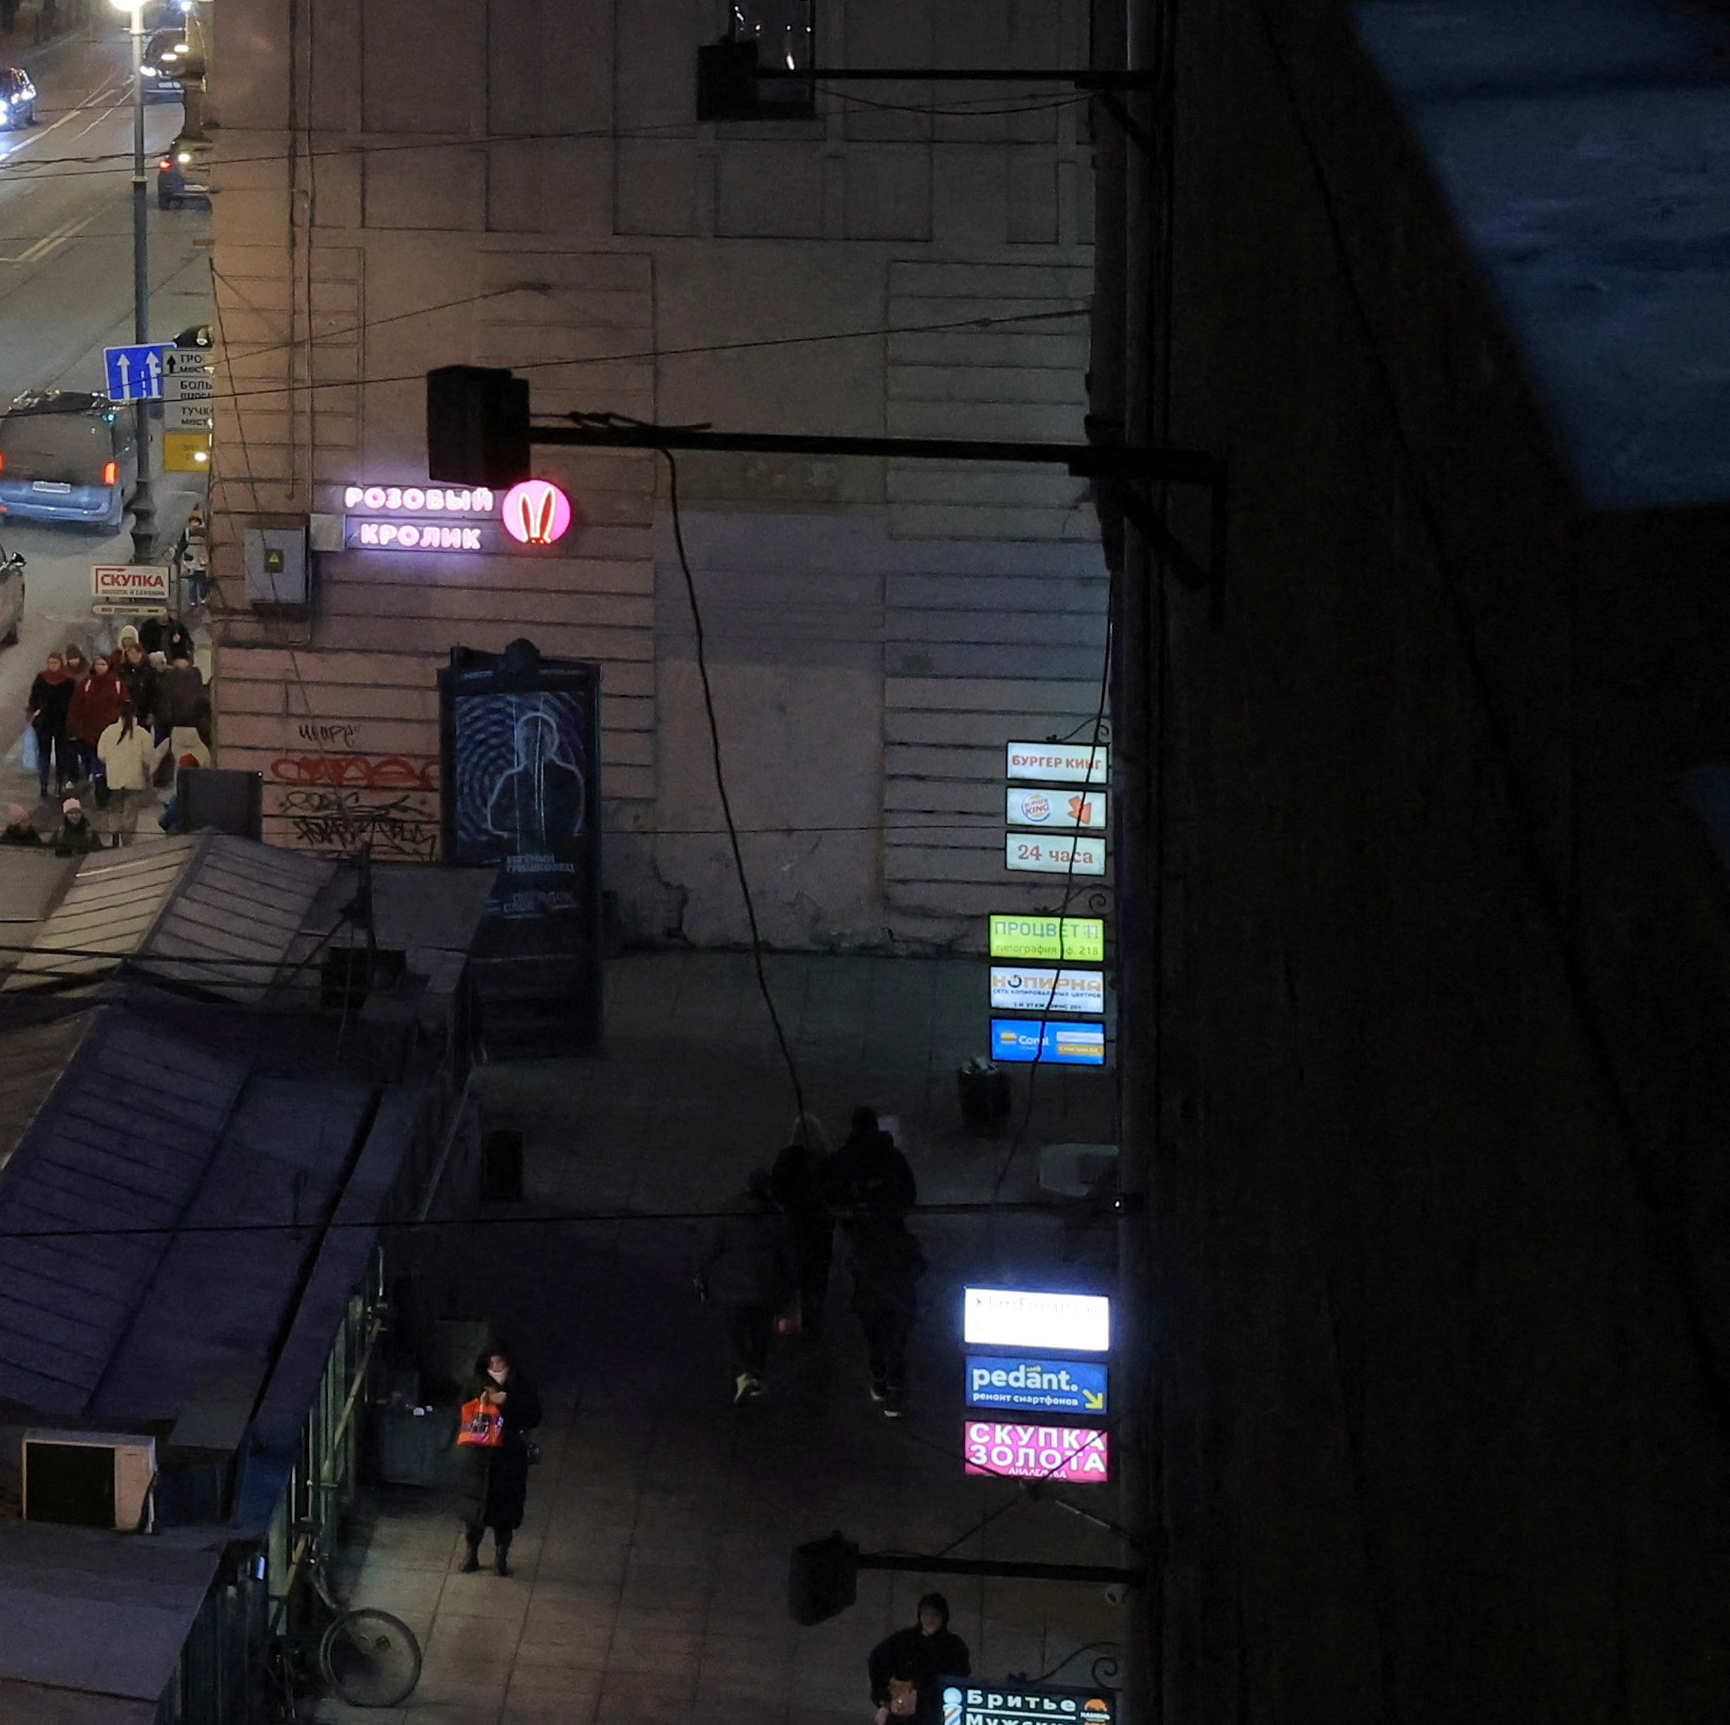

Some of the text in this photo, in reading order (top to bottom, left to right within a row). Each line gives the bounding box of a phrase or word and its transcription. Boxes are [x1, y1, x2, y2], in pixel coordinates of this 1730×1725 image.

[180, 355, 206, 363] ТРО
[182, 406, 213, 415] ТУЧК
[344, 487, 494, 512] РОЗОВЫЙ
[360, 523, 482, 550] КРОЛИК
[101, 574, 164, 587] СКУПКА
[1012, 755, 1062, 768] БУРГЕР
[1018, 844, 1093, 864] 24 часа
[995, 921, 1079, 938] ПРОЦВЕТ
[973, 1365, 1078, 1392] pedant.
[973, 1392, 1078, 1406] ремонт смартфонов
[969, 1423, 1105, 1451] СКУПКА
[969, 1444, 1105, 1473] ЗОЛОТА
[967, 1690, 1076, 1712] Бритье
